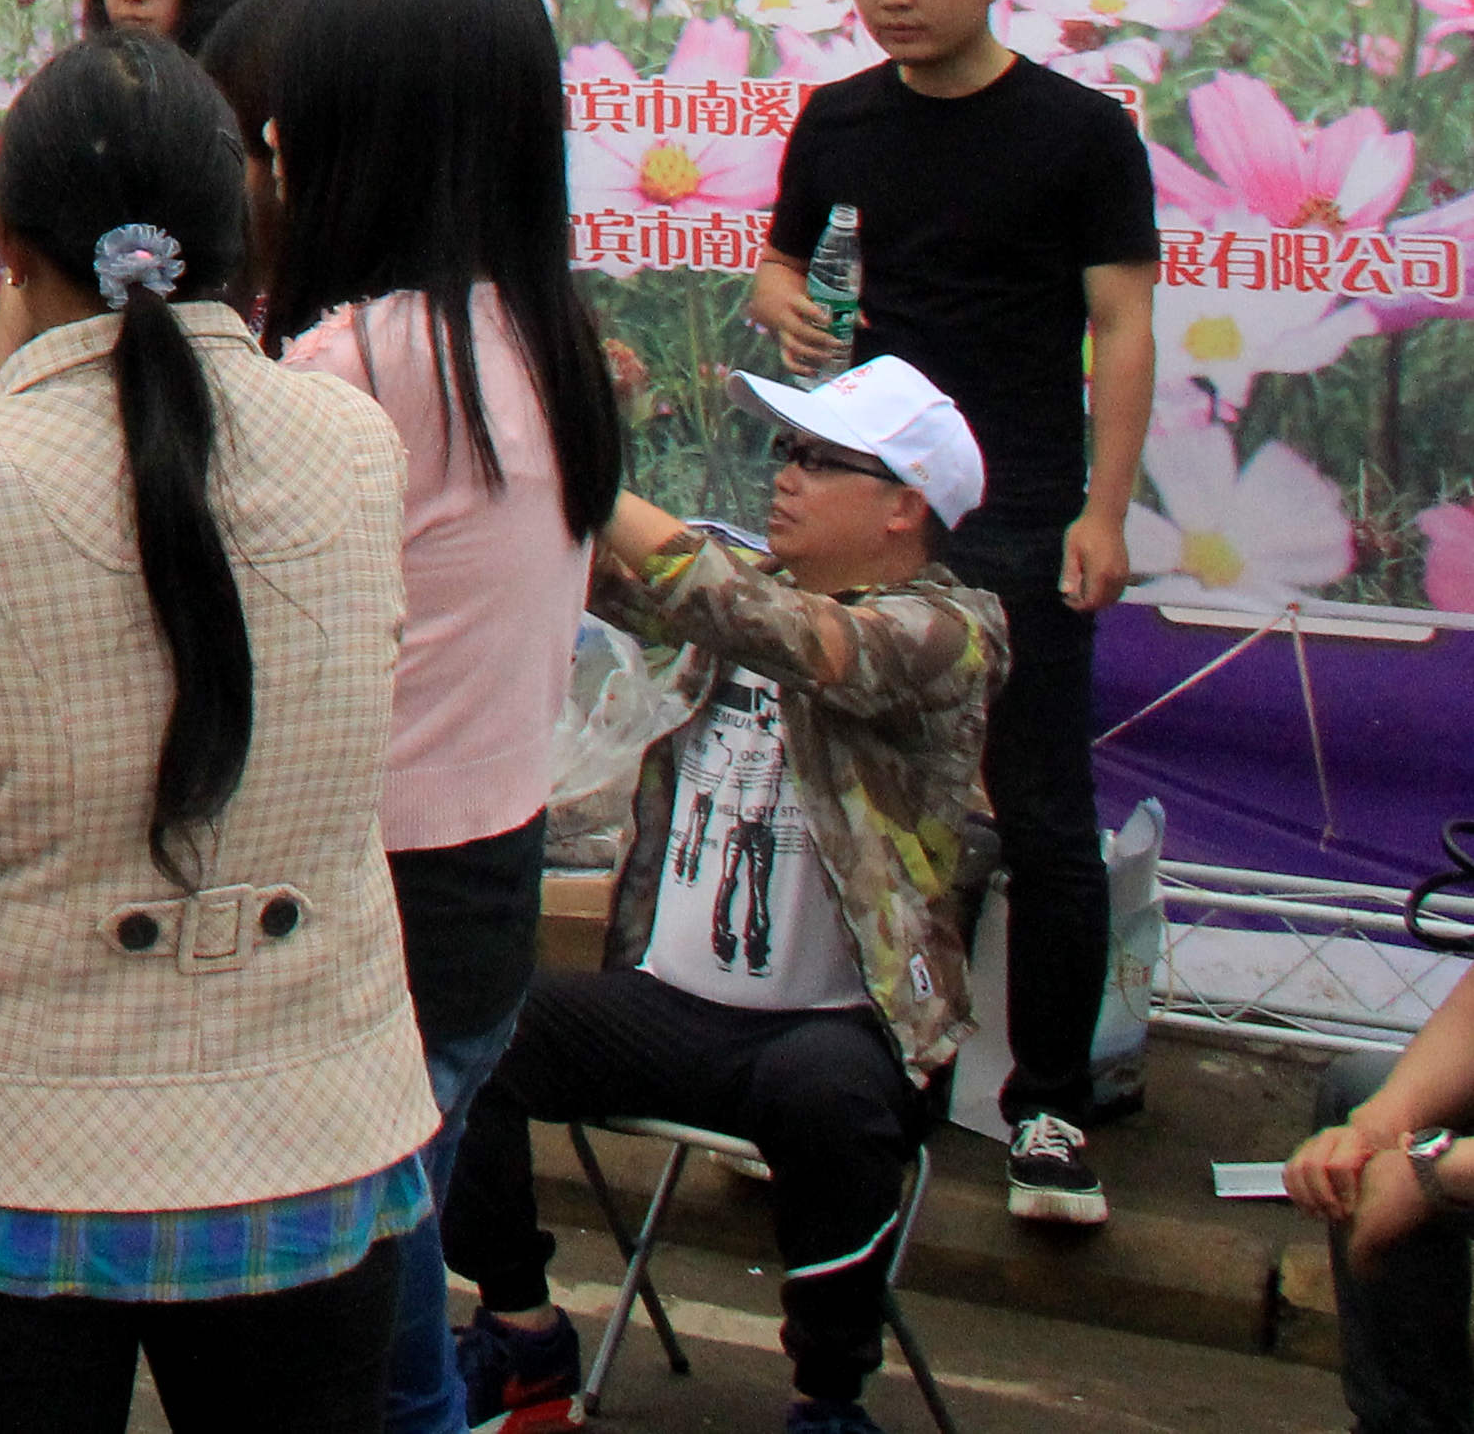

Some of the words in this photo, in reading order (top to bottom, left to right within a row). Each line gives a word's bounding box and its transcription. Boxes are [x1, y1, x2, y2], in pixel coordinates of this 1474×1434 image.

[563, 77, 829, 137] 宾市南溪
[1155, 229, 1459, 299] 展有限公司
